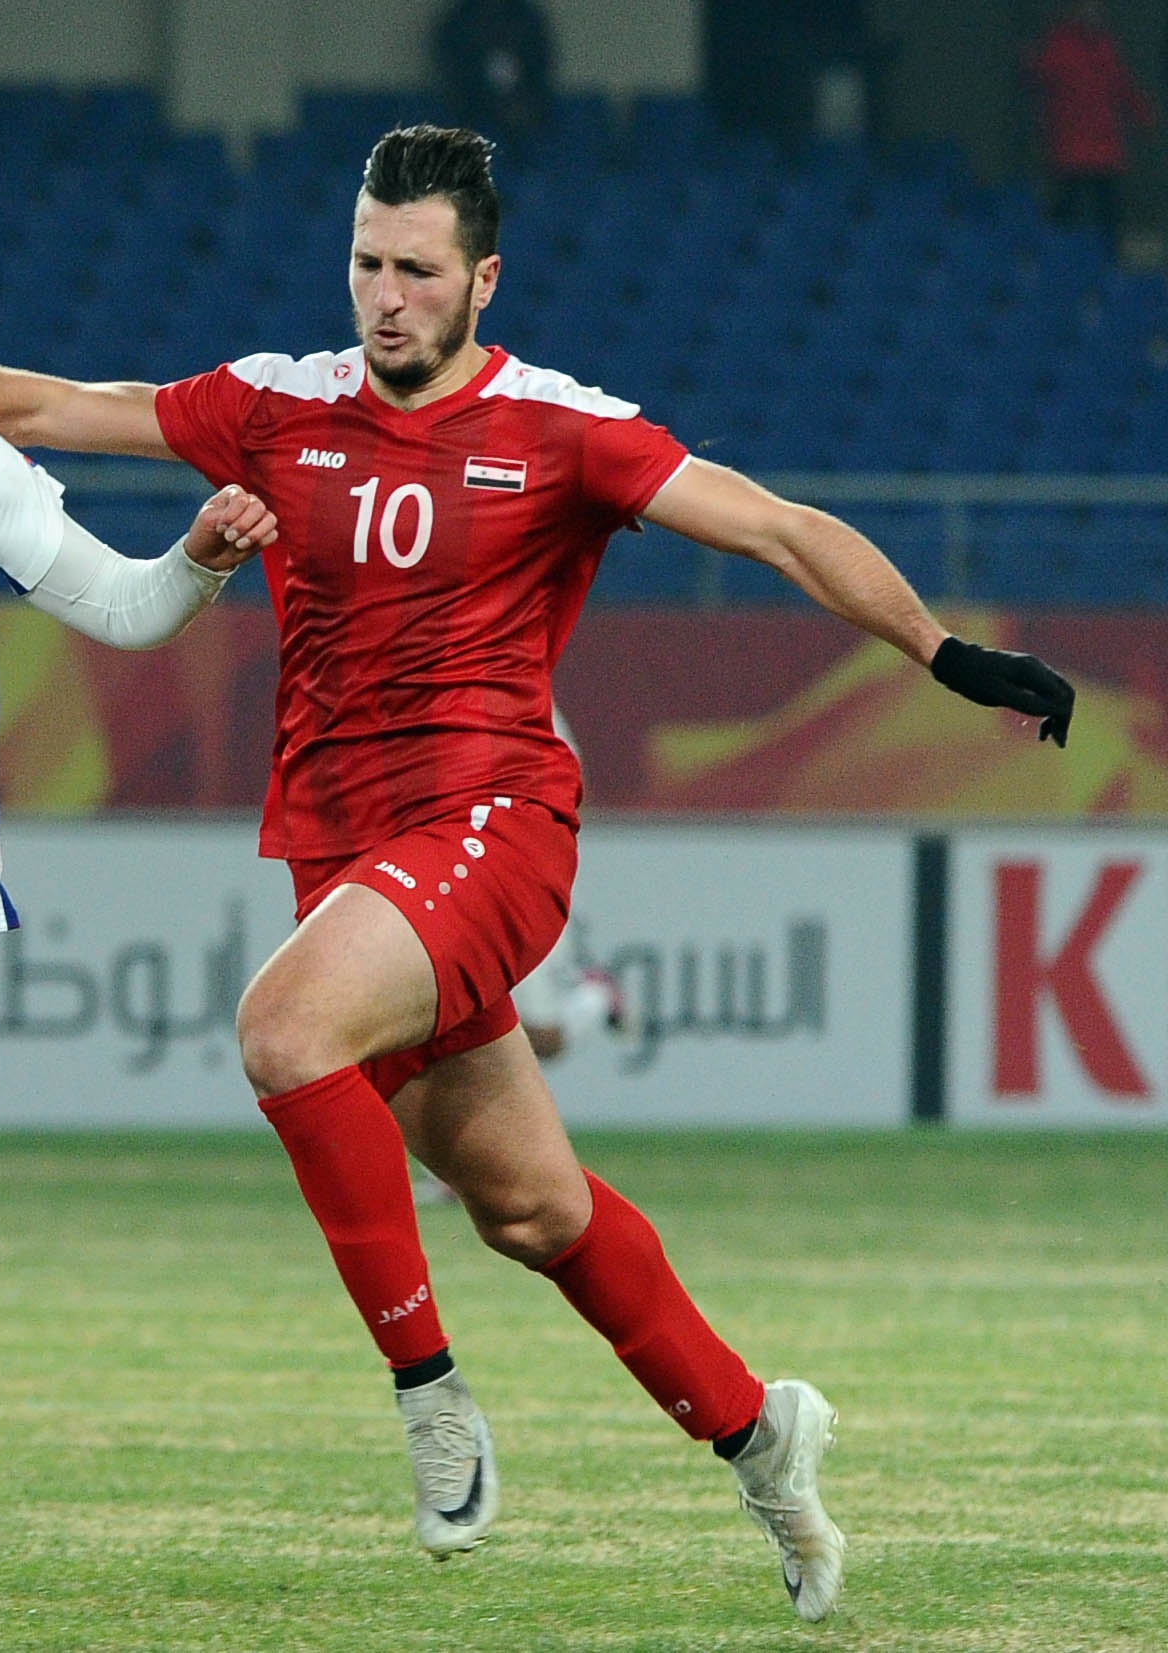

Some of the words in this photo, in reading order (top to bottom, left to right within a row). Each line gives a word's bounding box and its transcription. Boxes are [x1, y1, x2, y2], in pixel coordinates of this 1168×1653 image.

[296, 448, 346, 469] JAKO
[350, 477, 433, 569] 10
[374, 861, 417, 889] JAKO
[992, 860, 1150, 1098] K
[378, 1284, 429, 1324] JAKO
